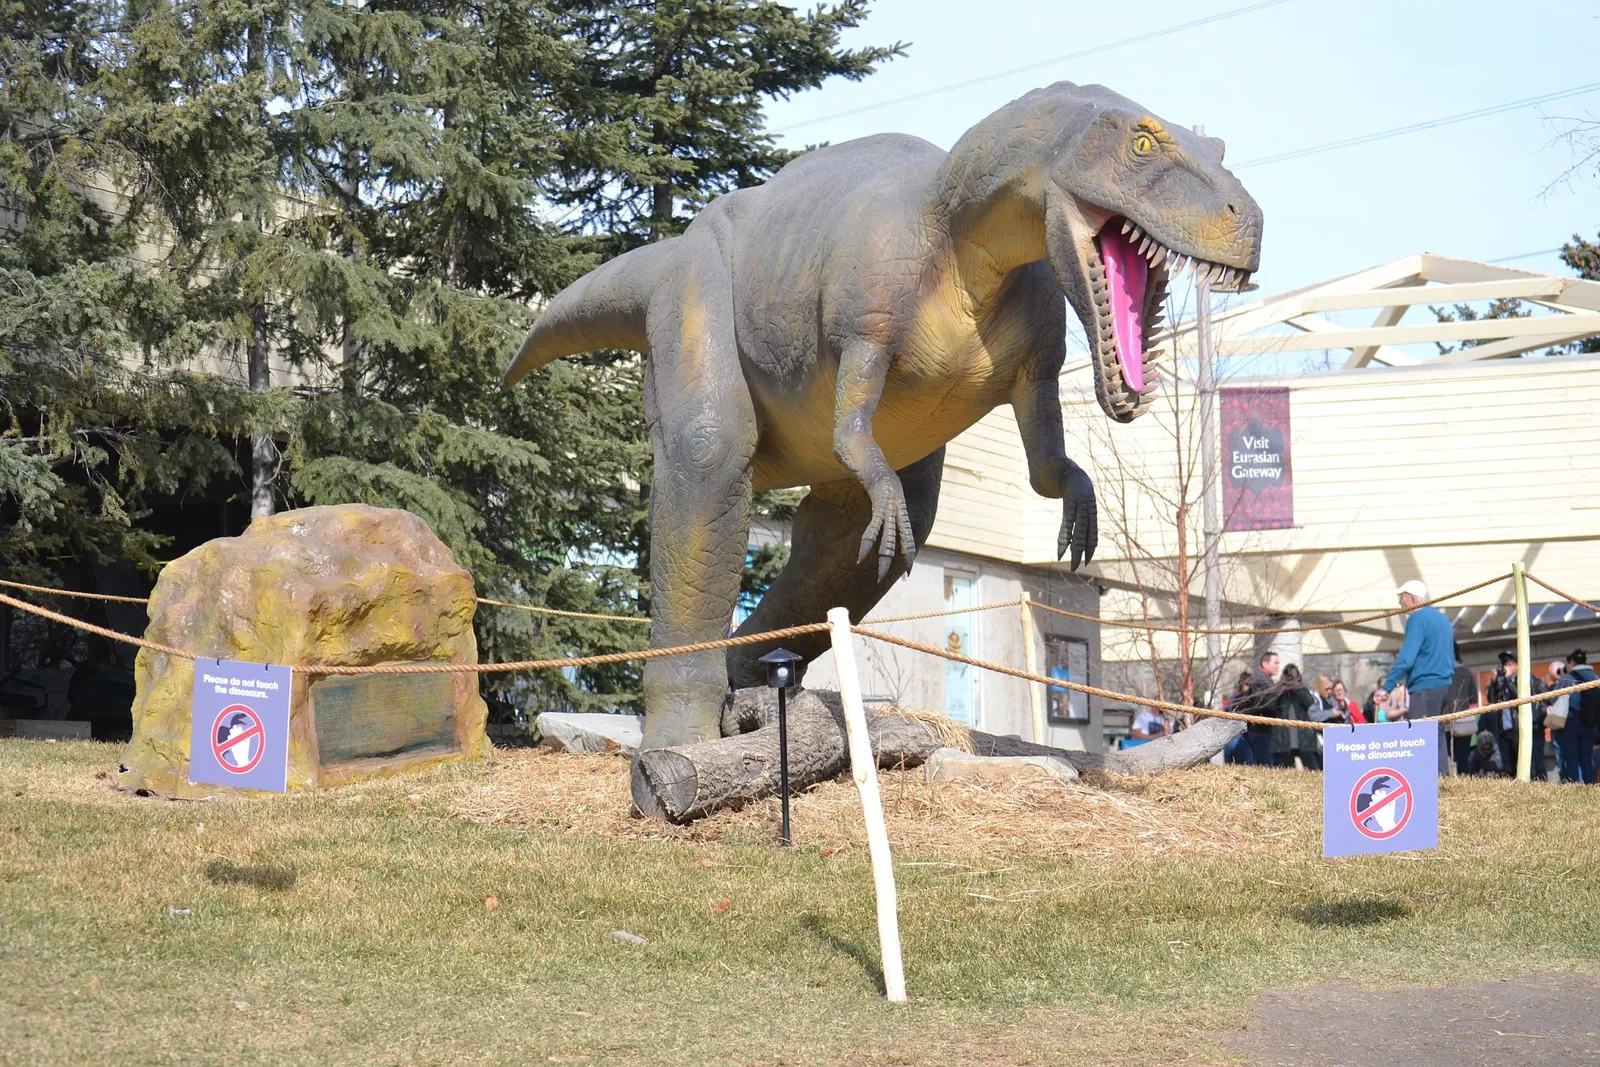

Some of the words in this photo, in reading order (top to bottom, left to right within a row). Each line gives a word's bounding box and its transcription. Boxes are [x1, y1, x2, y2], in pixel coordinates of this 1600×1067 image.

[1242, 436, 1270, 449] Visit
[1232, 451, 1280, 463] Eurasian
[1231, 466, 1282, 479] Gateway
[203, 674, 228, 685] Please
[230, 677, 240, 686] do
[242, 679, 255, 687] not
[256, 680, 279, 690] touch
[215, 685, 227, 694] the
[229, 686, 268, 698] dinosaurs.
[1336, 743, 1366, 752] Please
[1368, 741, 1380, 750] do
[1383, 740, 1397, 749] not
[1399, 737, 1425, 747] touch
[1351, 752, 1365, 761] the
[1368, 749, 1413, 760] dinosaurs.
